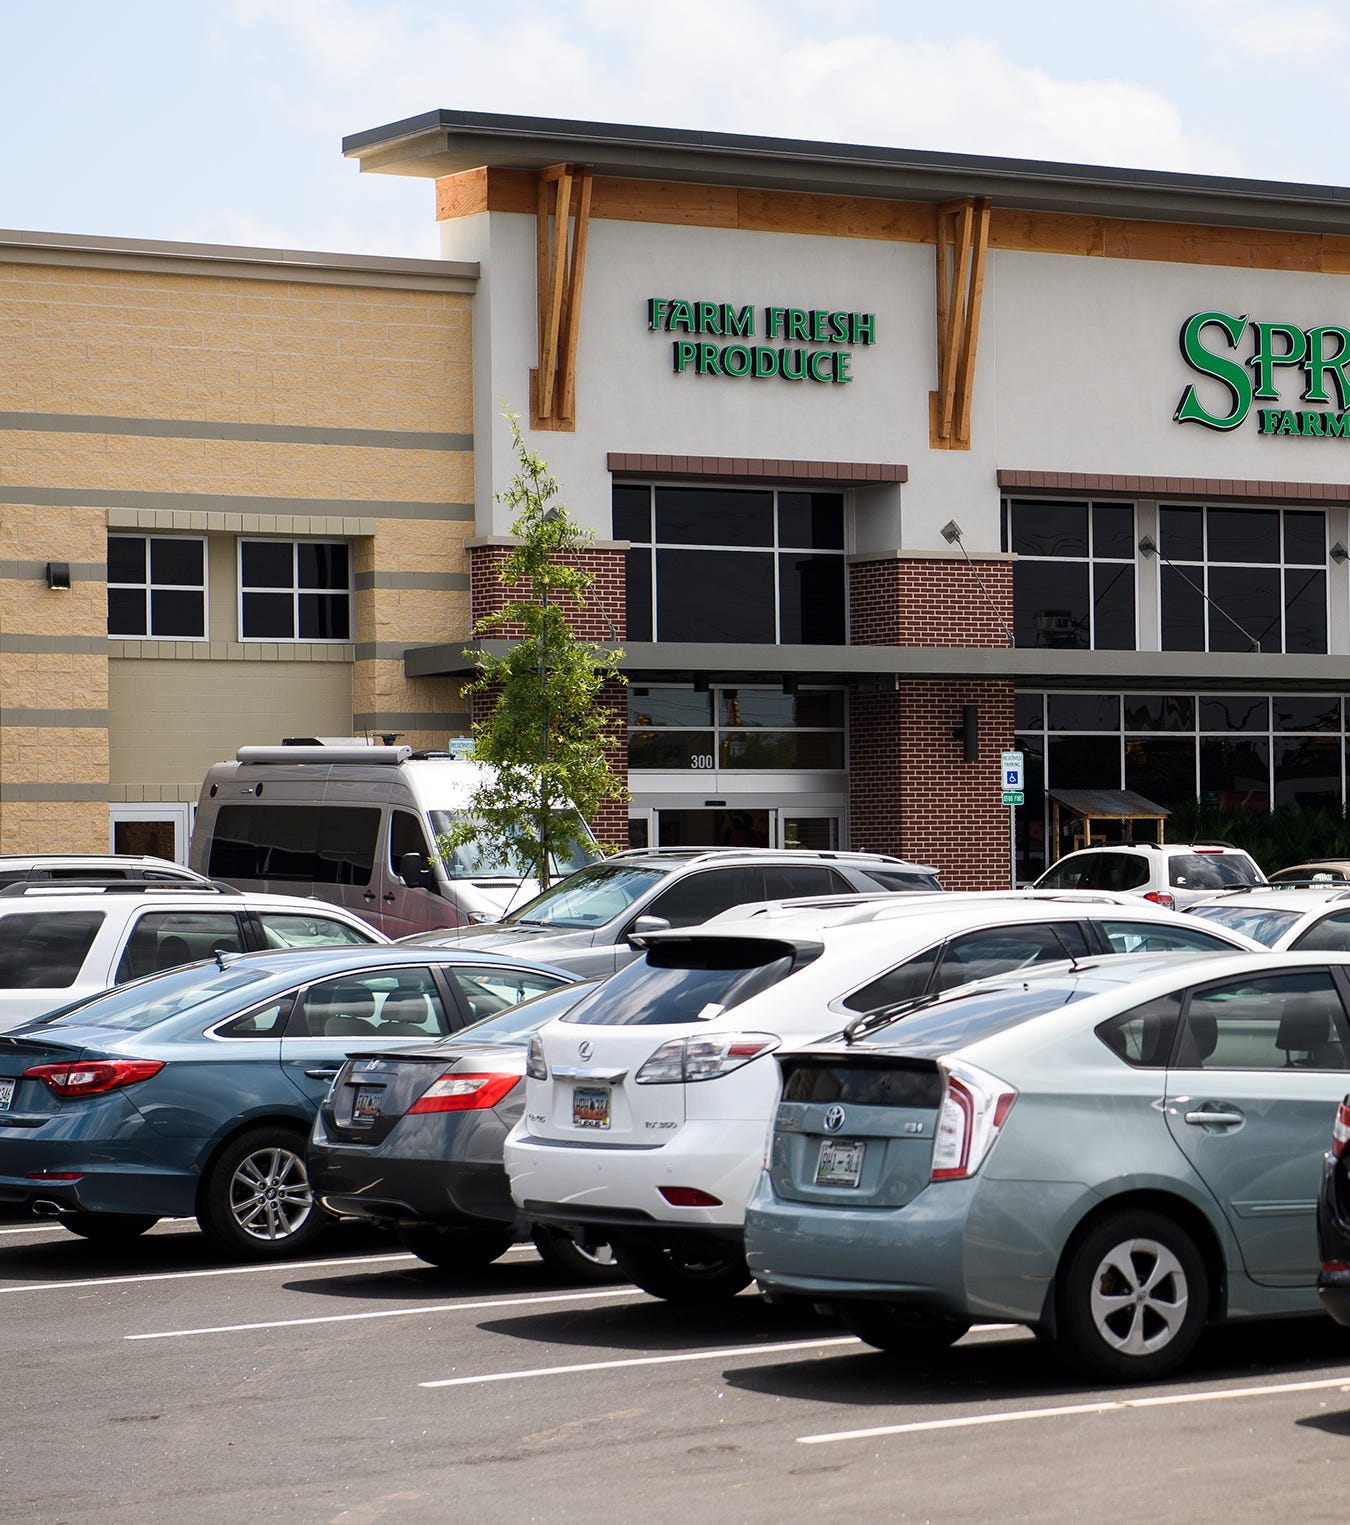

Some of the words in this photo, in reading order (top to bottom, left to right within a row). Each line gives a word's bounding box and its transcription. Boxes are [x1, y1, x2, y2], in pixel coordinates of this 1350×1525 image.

[648, 298, 755, 336] FARM
[765, 307, 876, 344] FRESH
[673, 341, 853, 383] PRODUCE
[691, 754, 713, 768] 300
